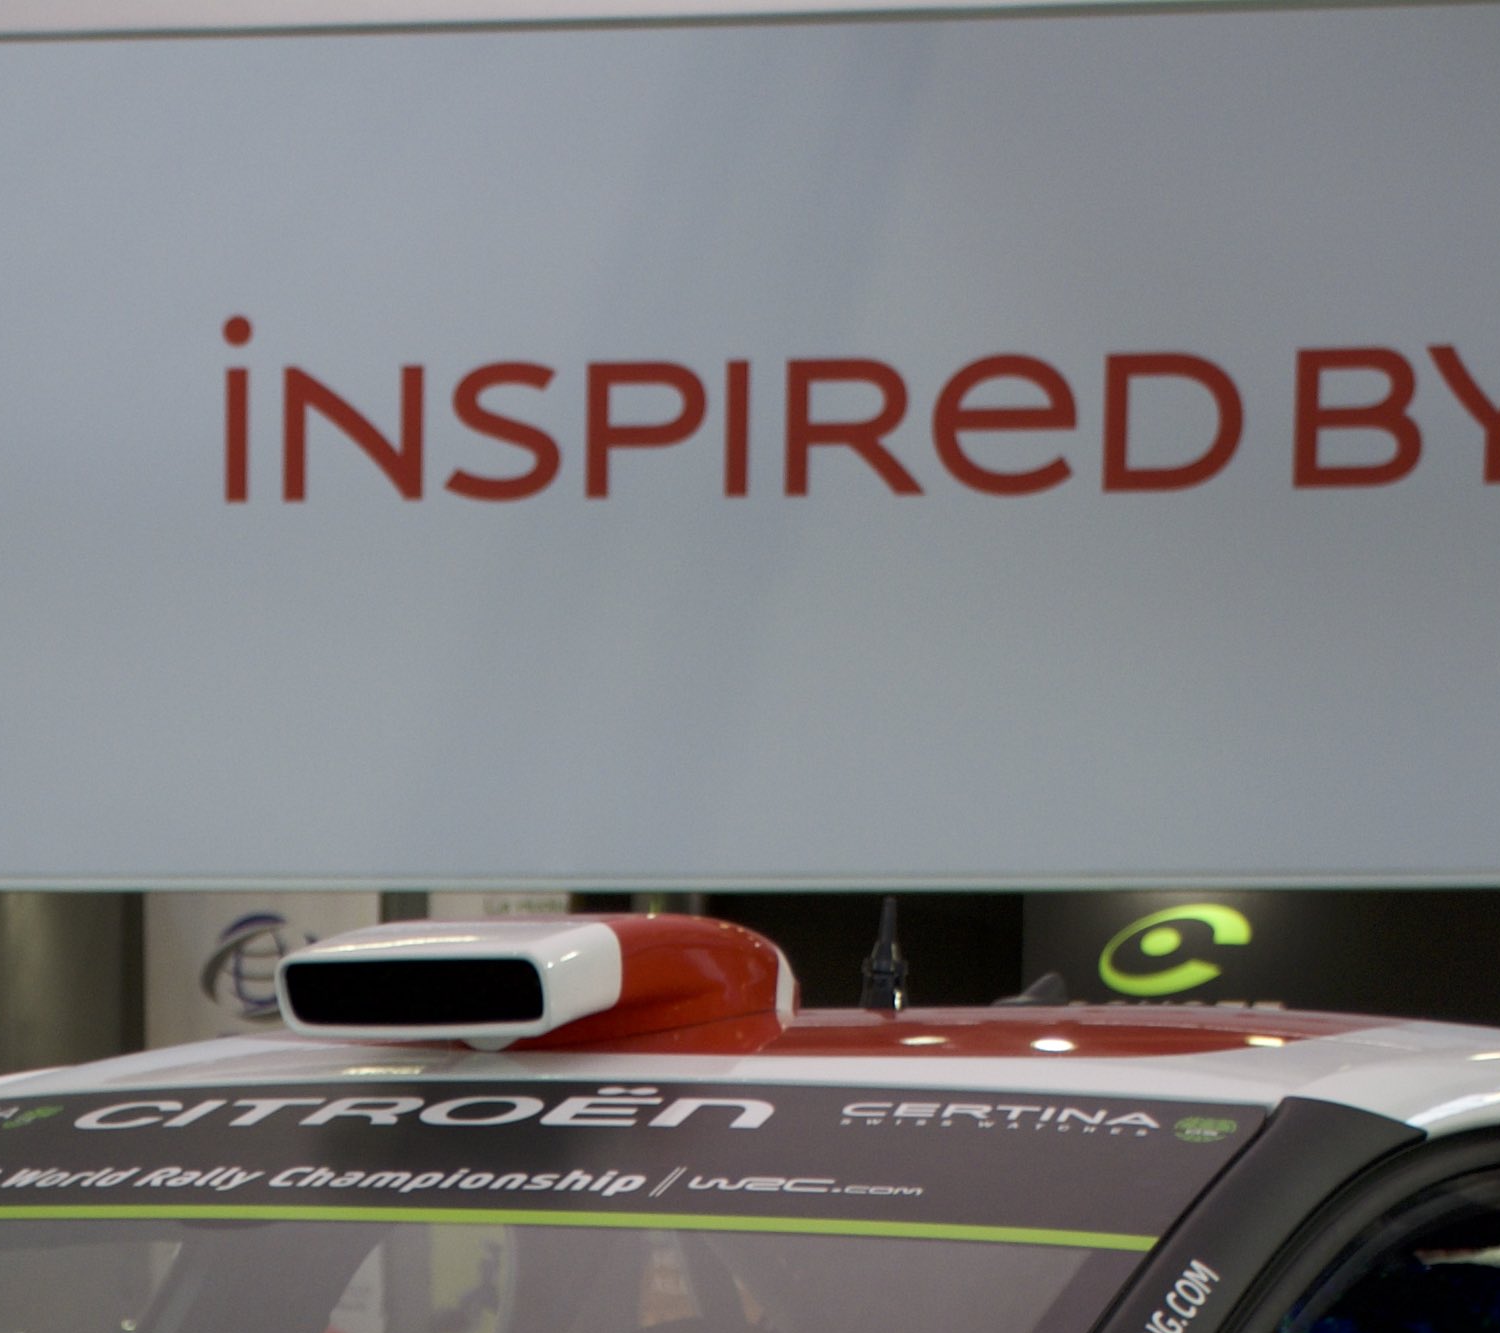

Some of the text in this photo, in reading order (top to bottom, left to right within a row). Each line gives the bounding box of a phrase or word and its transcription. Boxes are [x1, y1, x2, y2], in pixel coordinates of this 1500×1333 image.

[841, 1101, 1160, 1129] CERTINA
[1, 1167, 140, 1189] World
[134, 1167, 264, 1191] Rally
[268, 1167, 647, 1196] Championship
